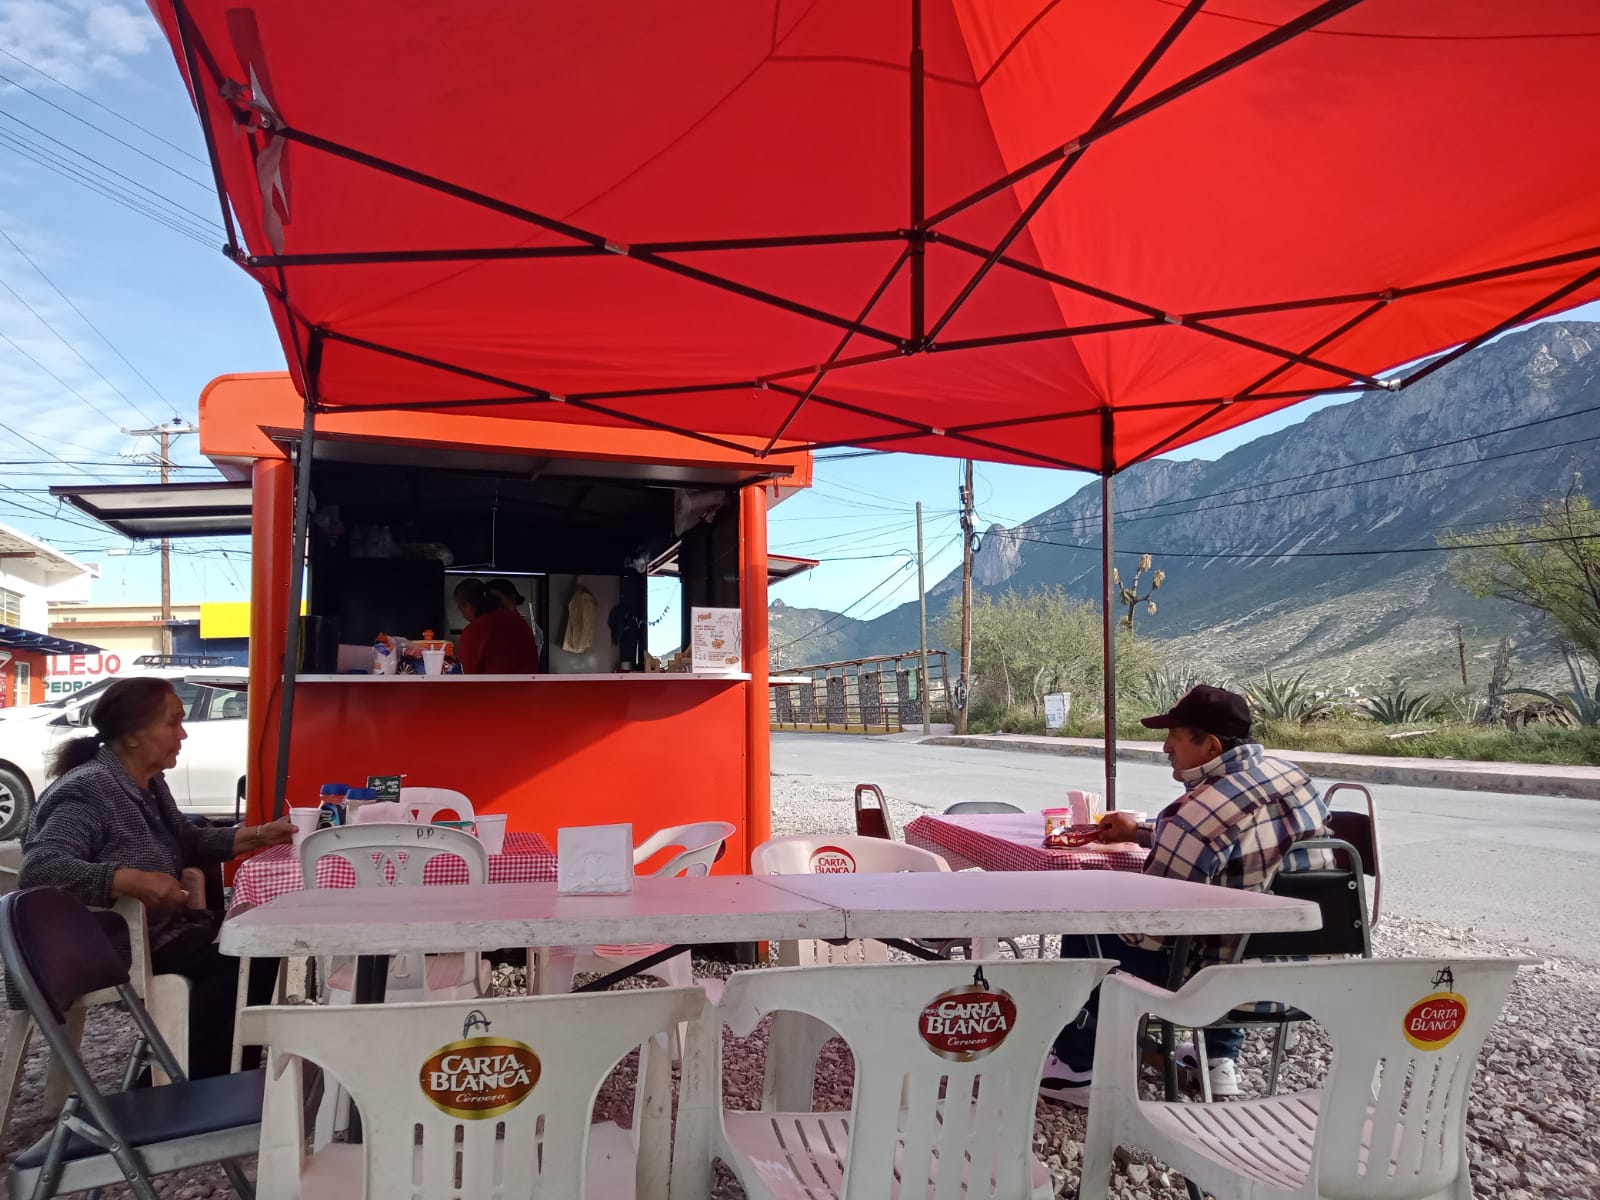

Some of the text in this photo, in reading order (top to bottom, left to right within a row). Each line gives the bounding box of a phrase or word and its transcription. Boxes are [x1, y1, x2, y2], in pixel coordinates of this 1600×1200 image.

[818, 857, 847, 867] CARTA
[938, 1001, 1001, 1020] CARTA
[1421, 1007, 1458, 1020] CARTA
[926, 1016, 1008, 1035] BLANCA
[1410, 1018, 1457, 1031] BLANCA
[946, 1036, 988, 1047] Cerveza
[441, 1054, 519, 1075] CARTA
[429, 1069, 531, 1092] BLANCA
[455, 1092, 505, 1104] Cerveza
